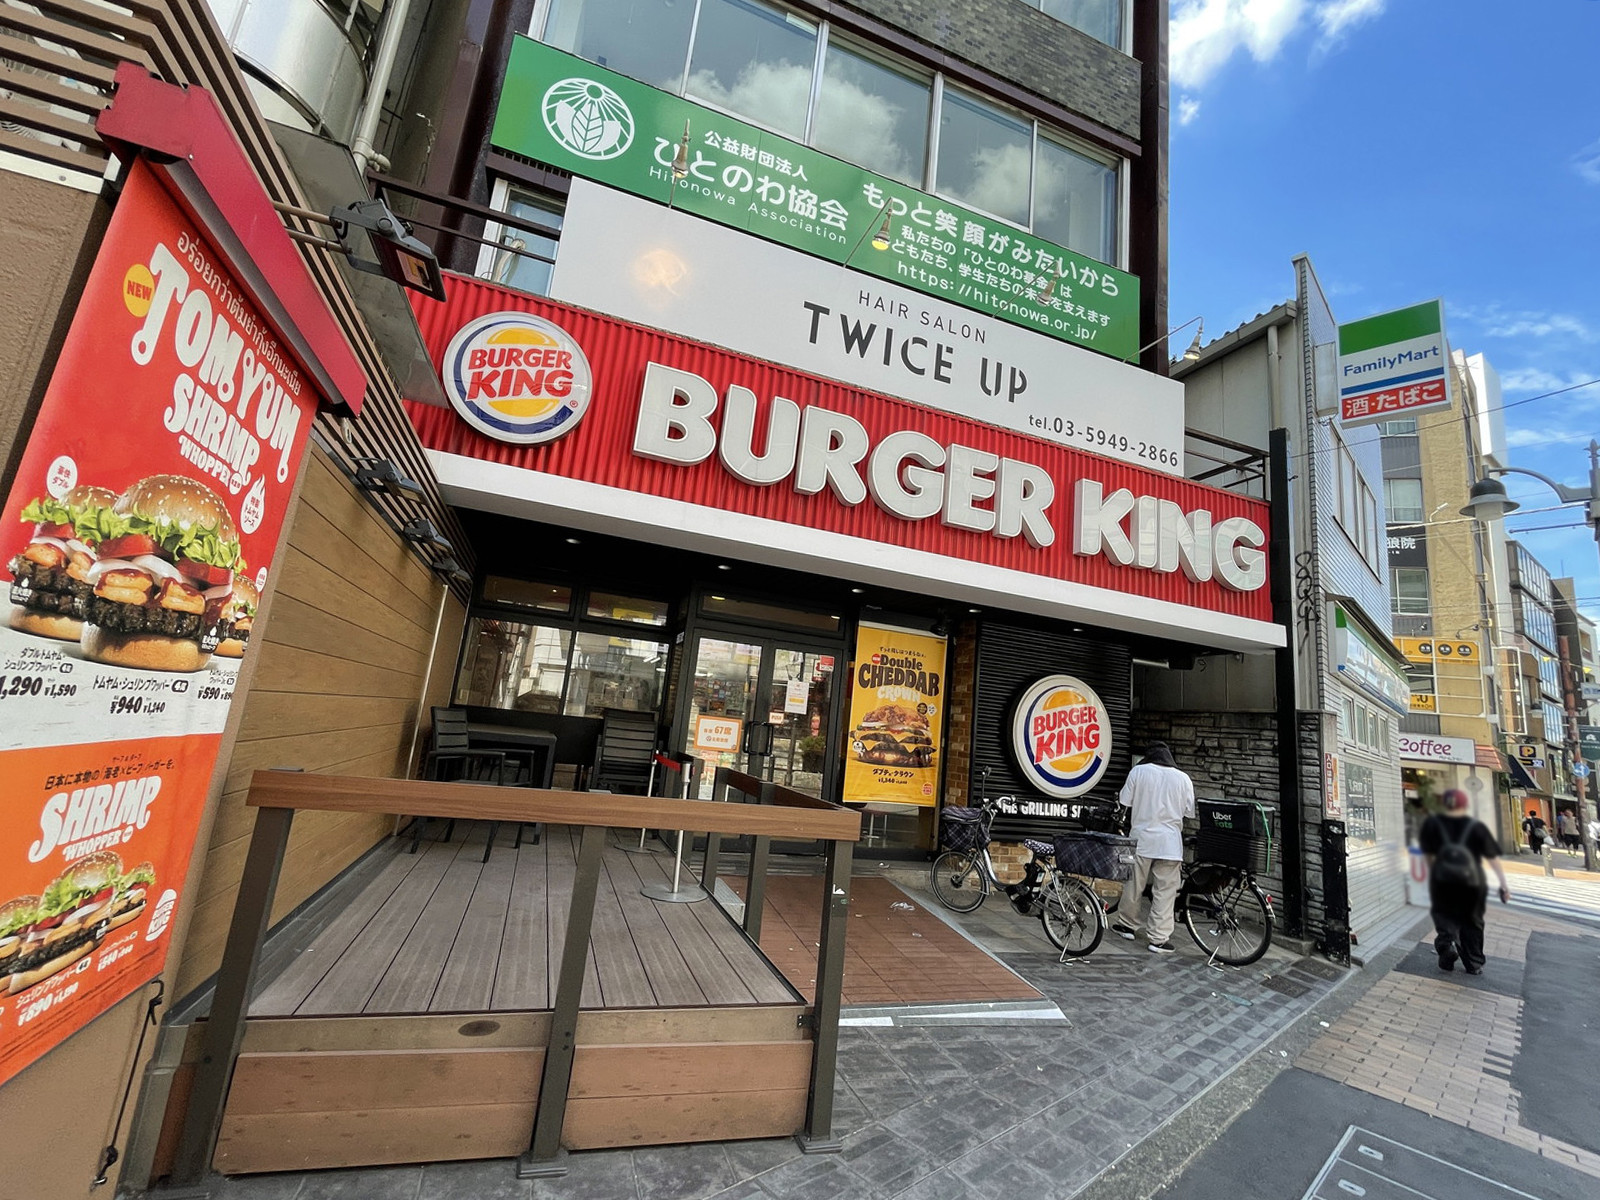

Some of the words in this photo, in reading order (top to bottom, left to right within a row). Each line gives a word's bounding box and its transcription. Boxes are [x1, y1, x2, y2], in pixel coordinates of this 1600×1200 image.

[704, 130, 808, 182] 公益財団法人
[654, 136, 849, 231] ひとのわ協会
[748, 202, 847, 245] Association
[863, 183, 1119, 297] もっと笑顔がみたいから
[126, 279, 153, 301] NEW
[898, 261, 1097, 340] https://hitonowa.or.jp/
[860, 289, 909, 320] HAIR
[920, 311, 986, 344] SALON
[131, 242, 244, 403] TOM
[237, 348, 302, 484] YUM
[468, 348, 573, 370] BURGER
[803, 301, 953, 385] TWICE
[980, 356, 1028, 403] UP
[1344, 345, 1439, 377] FamilyMart
[467, 369, 574, 401] KING
[1345, 382, 1443, 417] 酒・たばこ
[163, 373, 261, 487] SHRIMP
[1028, 413, 1179, 468] tel.03-5949-2866
[52, 476, 70, 489] ダブル
[631, 361, 1056, 549] BURGER
[1072, 477, 1268, 592] KING
[243, 515, 255, 527] ソース
[244, 504, 260, 520] トムヤム
[880, 654, 923, 670] Double
[45, 683, 77, 698] ¥1,590
[198, 687, 221, 700] ¥590
[858, 663, 940, 697] CHEDDAR
[877, 685, 921, 702] CROWN
[110, 696, 143, 714] ¥940
[1033, 705, 1098, 736] BURGER
[1034, 724, 1100, 763] KING
[28, 775, 162, 863] SHRIMP
[1021, 801, 1068, 817] GRILLING
[1212, 811, 1232, 821] Uber
[62, 829, 122, 862] WHOPPER
[147, 909, 173, 934] KING
[18, 993, 53, 1027] ¥890
